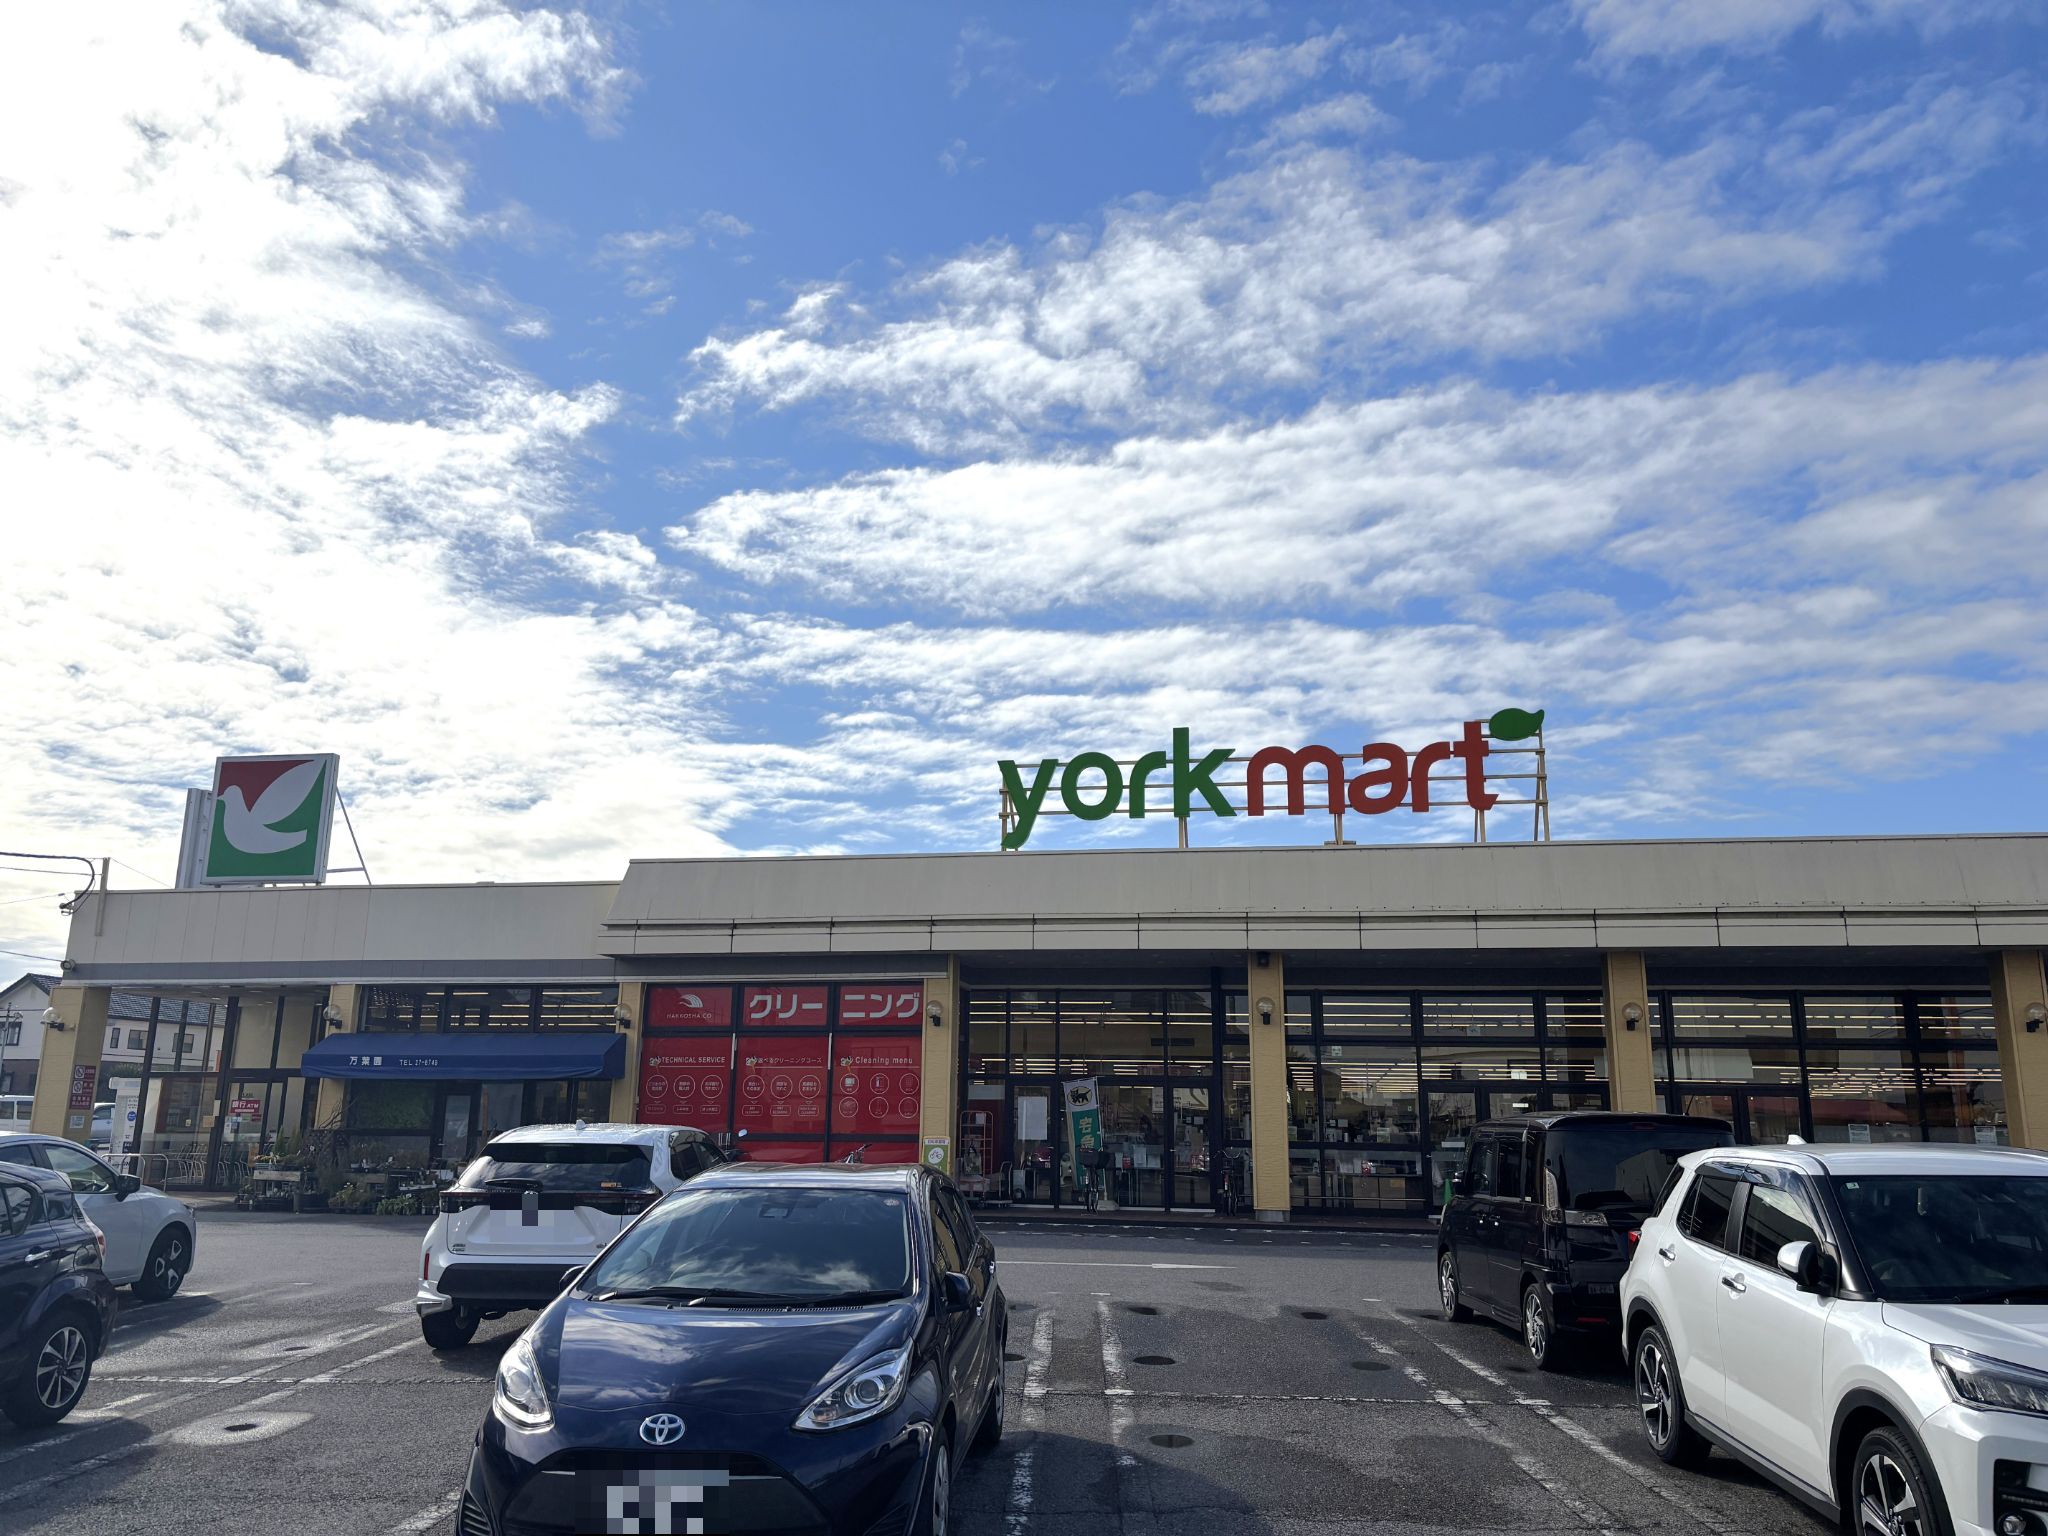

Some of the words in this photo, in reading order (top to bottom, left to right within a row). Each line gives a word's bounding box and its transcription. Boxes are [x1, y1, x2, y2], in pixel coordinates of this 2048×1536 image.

[997, 721, 1499, 849] yorkmart
[749, 992, 920, 1019] クリーニング
[661, 1056, 697, 1064] TECHNICAL
[698, 1056, 726, 1064] SERVICE
[855, 1056, 890, 1066] Cleaning
